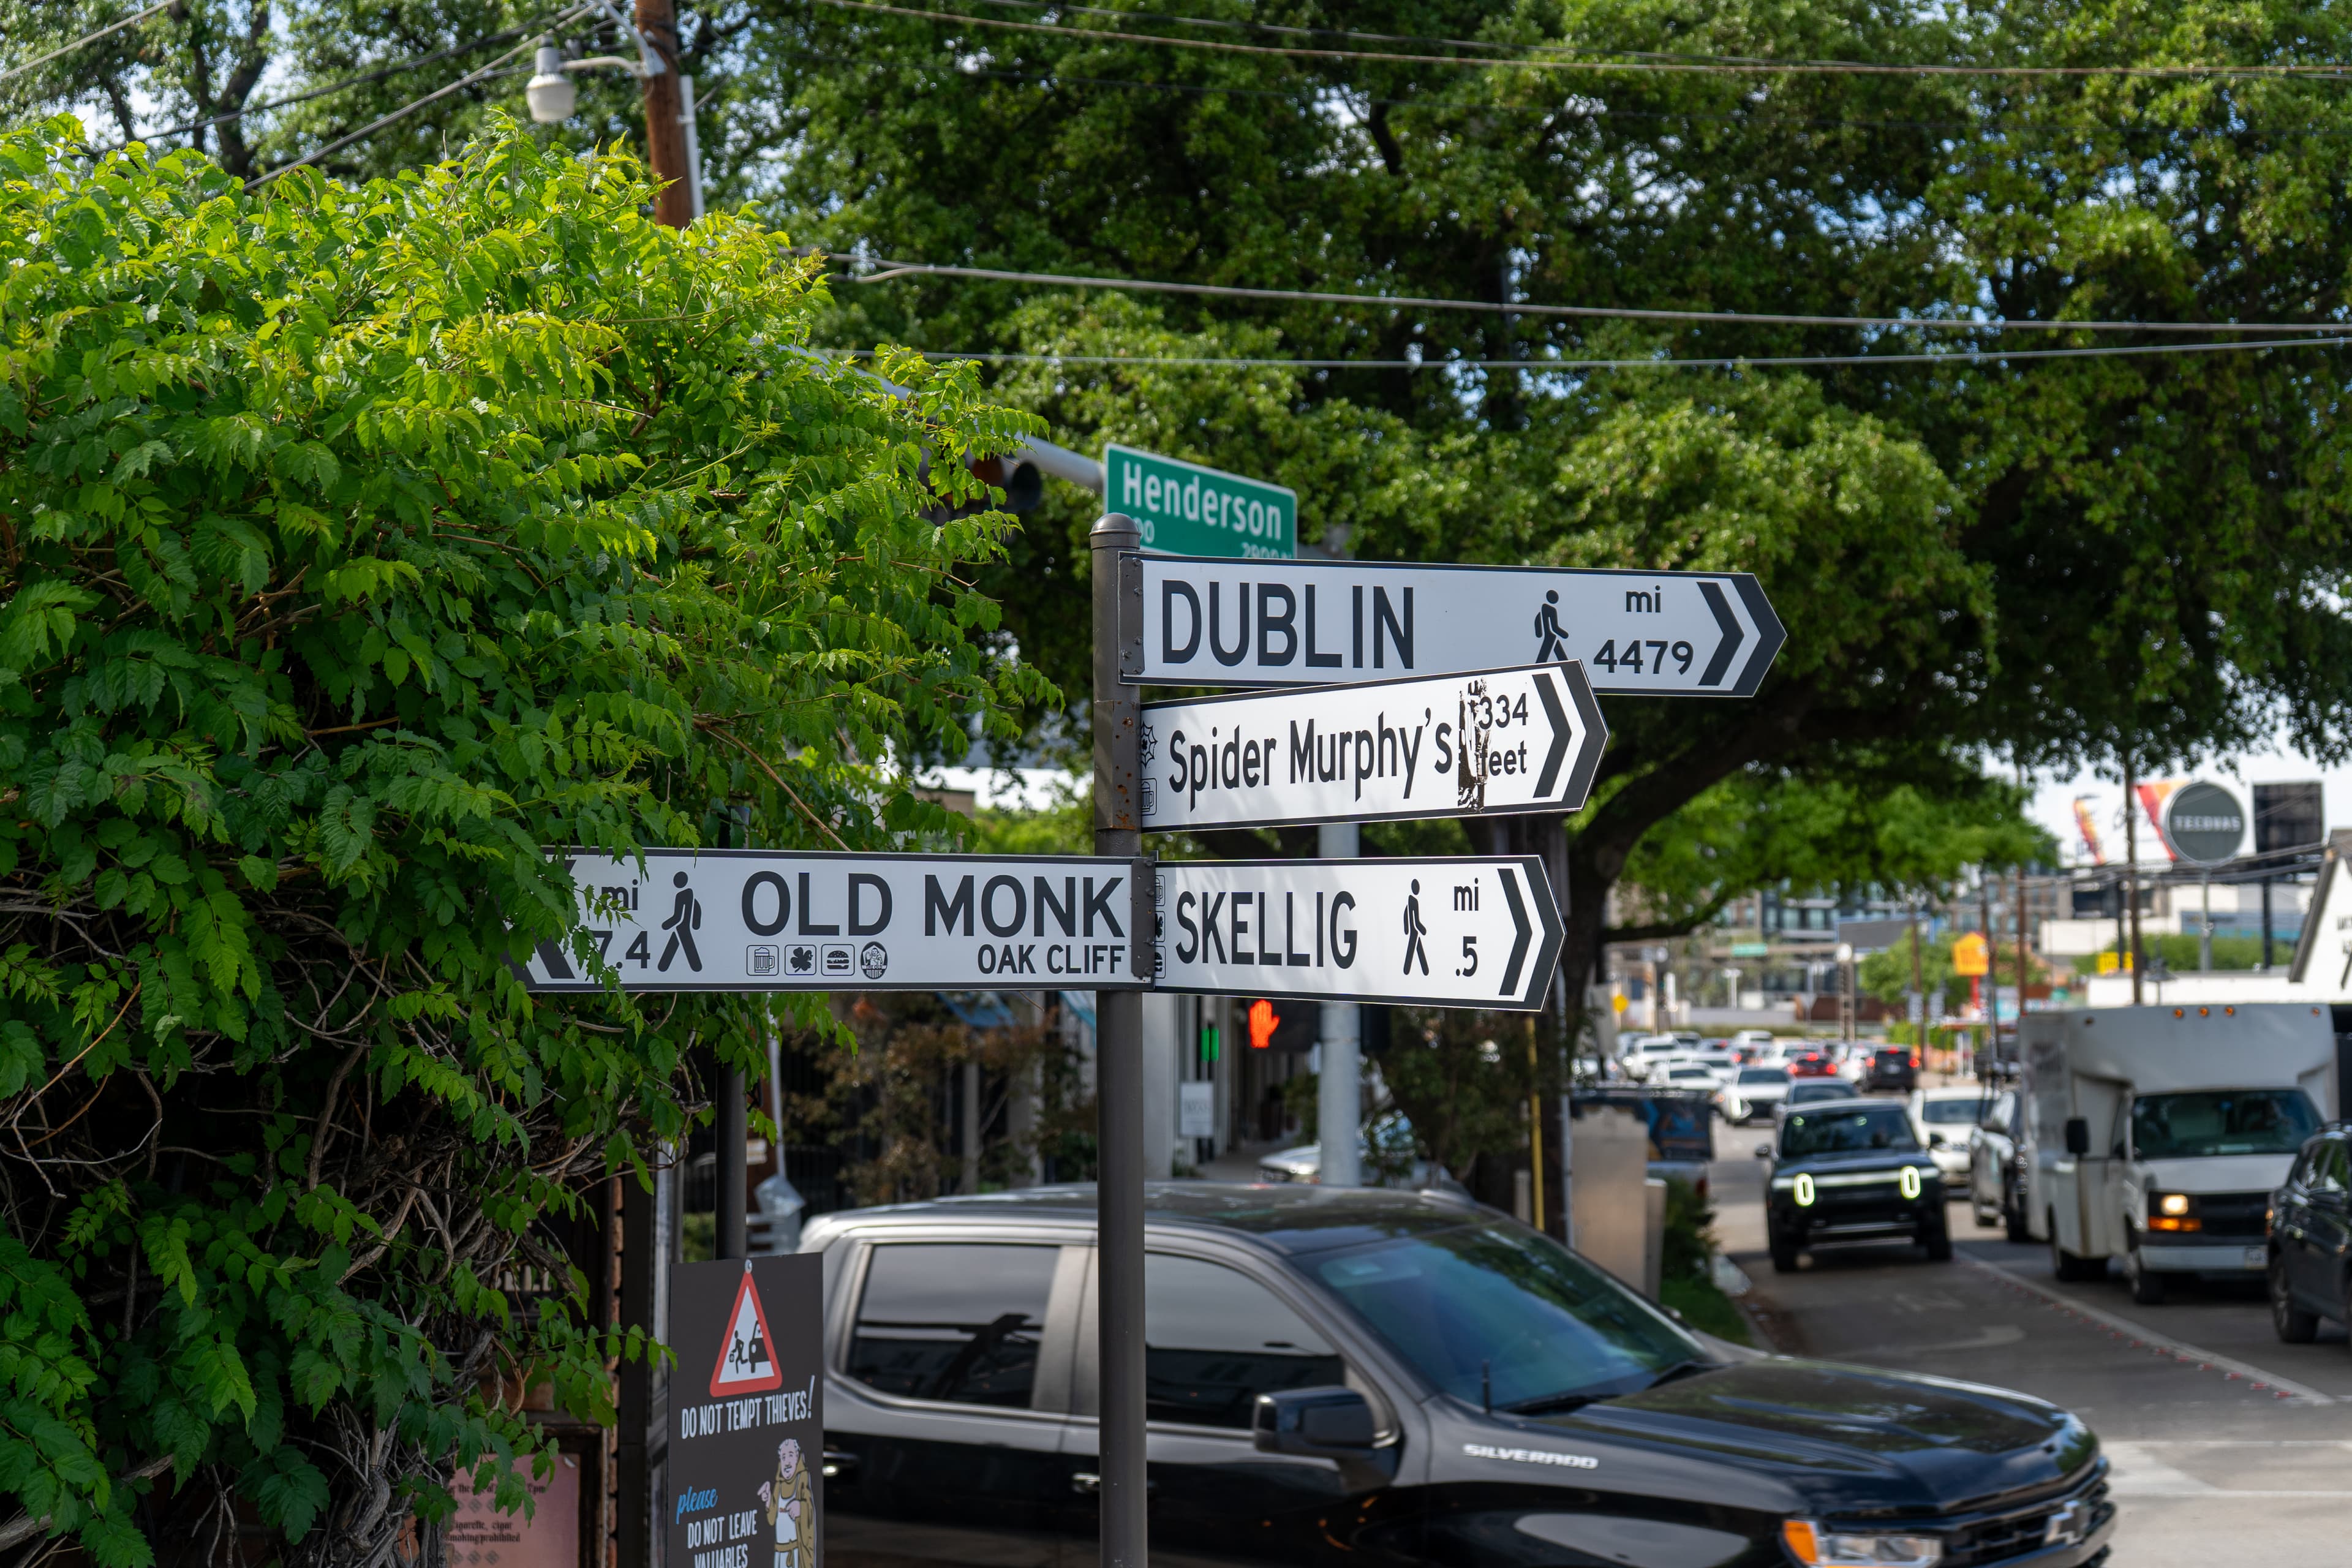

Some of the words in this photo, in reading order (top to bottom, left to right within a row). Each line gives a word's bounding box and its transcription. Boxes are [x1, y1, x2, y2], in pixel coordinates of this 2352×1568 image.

[1123, 461, 1281, 540] Henderson
[1626, 586, 1660, 612] mi
[1163, 580, 1414, 669] DUBLIN
[1594, 639, 1694, 675] 4479
[1479, 693, 1528, 729] 334
[1169, 725, 1277, 812] Spider
[1290, 707, 1453, 802] Murphy's
[601, 879, 638, 910] mi
[742, 871, 892, 936] OLD
[925, 875, 1126, 938] MONK
[1454, 878, 1479, 911] mi
[590, 930, 650, 968] 7.4
[1175, 891, 1357, 969] SKELLIG
[978, 944, 1036, 974] OAK
[1047, 944, 1125, 974] CLIFF
[1455, 936, 1478, 977] .5
[682, 1407, 697, 1439] DO
[699, 1404, 723, 1436] NOT
[726, 1397, 763, 1431] TEMPT
[765, 1374, 815, 1425] THIEVES!
[1463, 1443, 1599, 1469] SILVERADO
[676, 1486, 718, 1525] please
[455, 1520, 488, 1531] igarette,
[688, 1521, 701, 1549] DO
[703, 1517, 725, 1545] NOT
[729, 1509, 758, 1540] LEAVE
